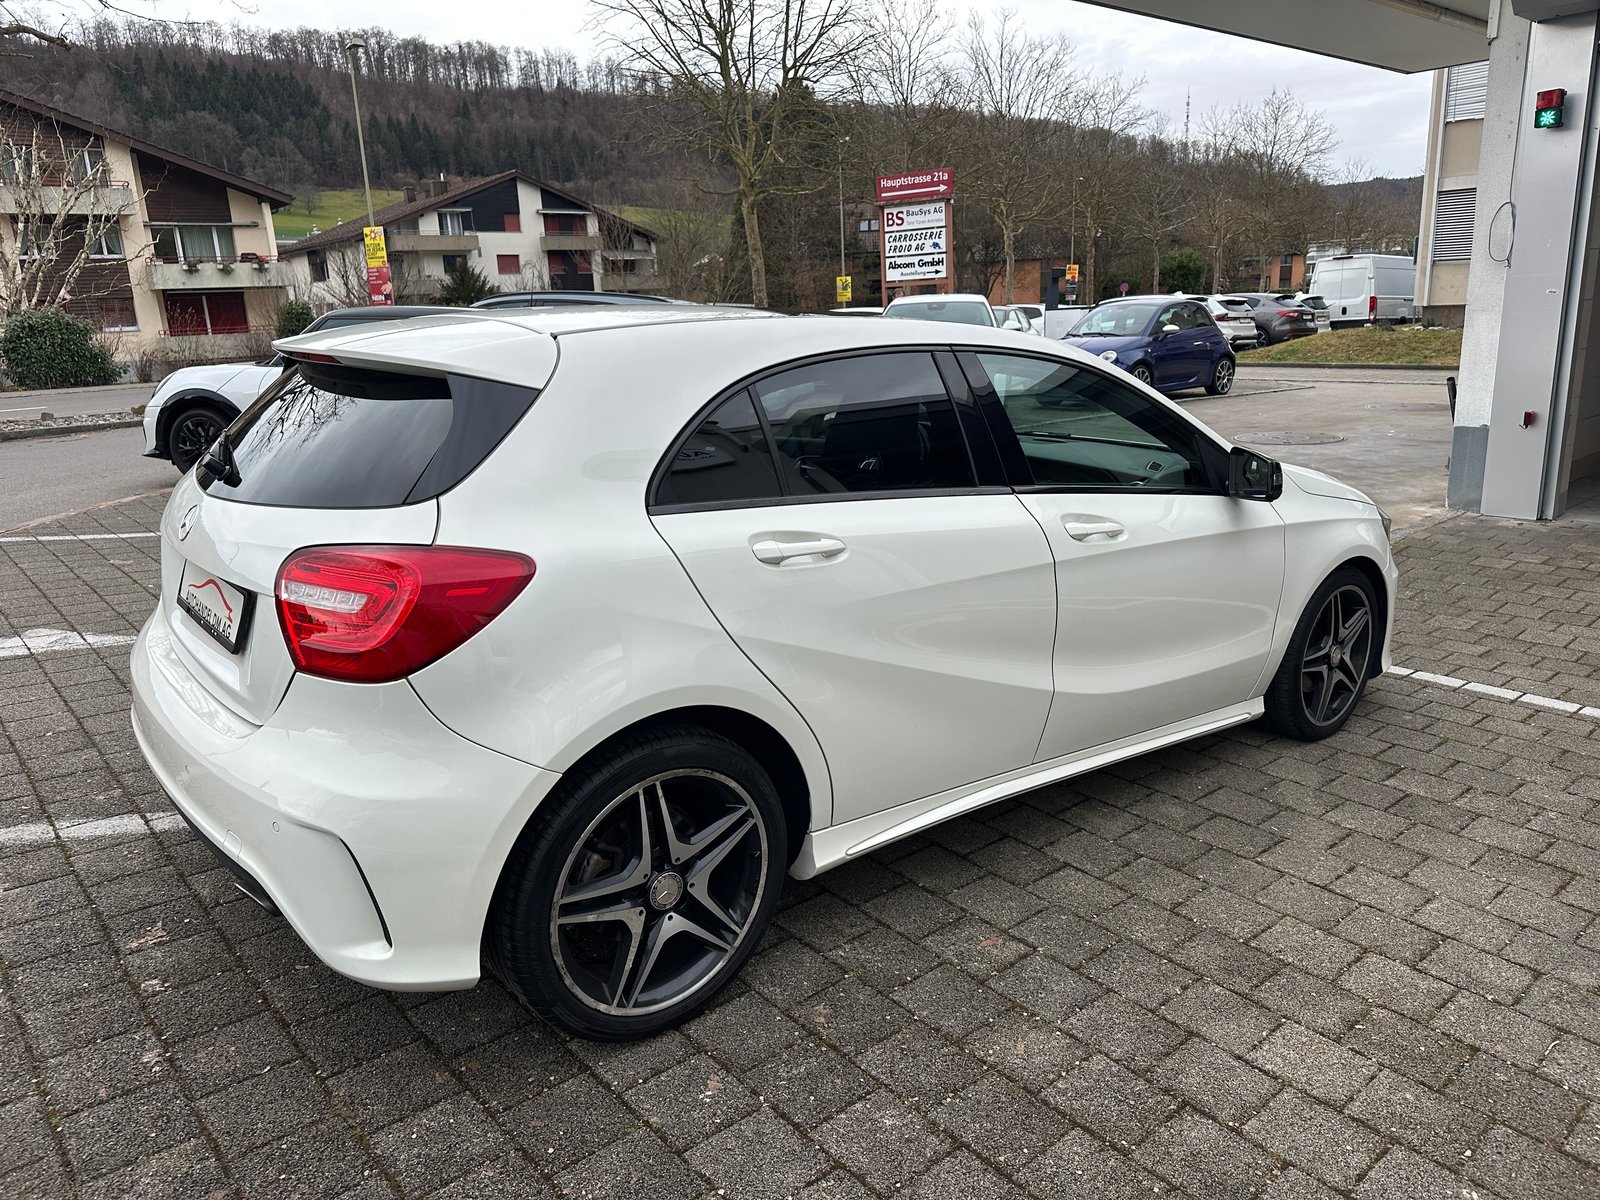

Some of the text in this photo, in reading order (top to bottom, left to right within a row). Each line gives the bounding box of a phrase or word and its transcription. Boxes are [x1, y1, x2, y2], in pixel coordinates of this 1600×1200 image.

[880, 172, 948, 188] Hauptstrasse 21a
[886, 210, 905, 227] BS
[906, 206, 943, 217] BauSys AG
[887, 230, 943, 244] CARROSSERIE
[888, 242, 925, 254] FROIO AG
[888, 257, 944, 270] Abcom GmbH
[221, 621, 232, 639] AG
